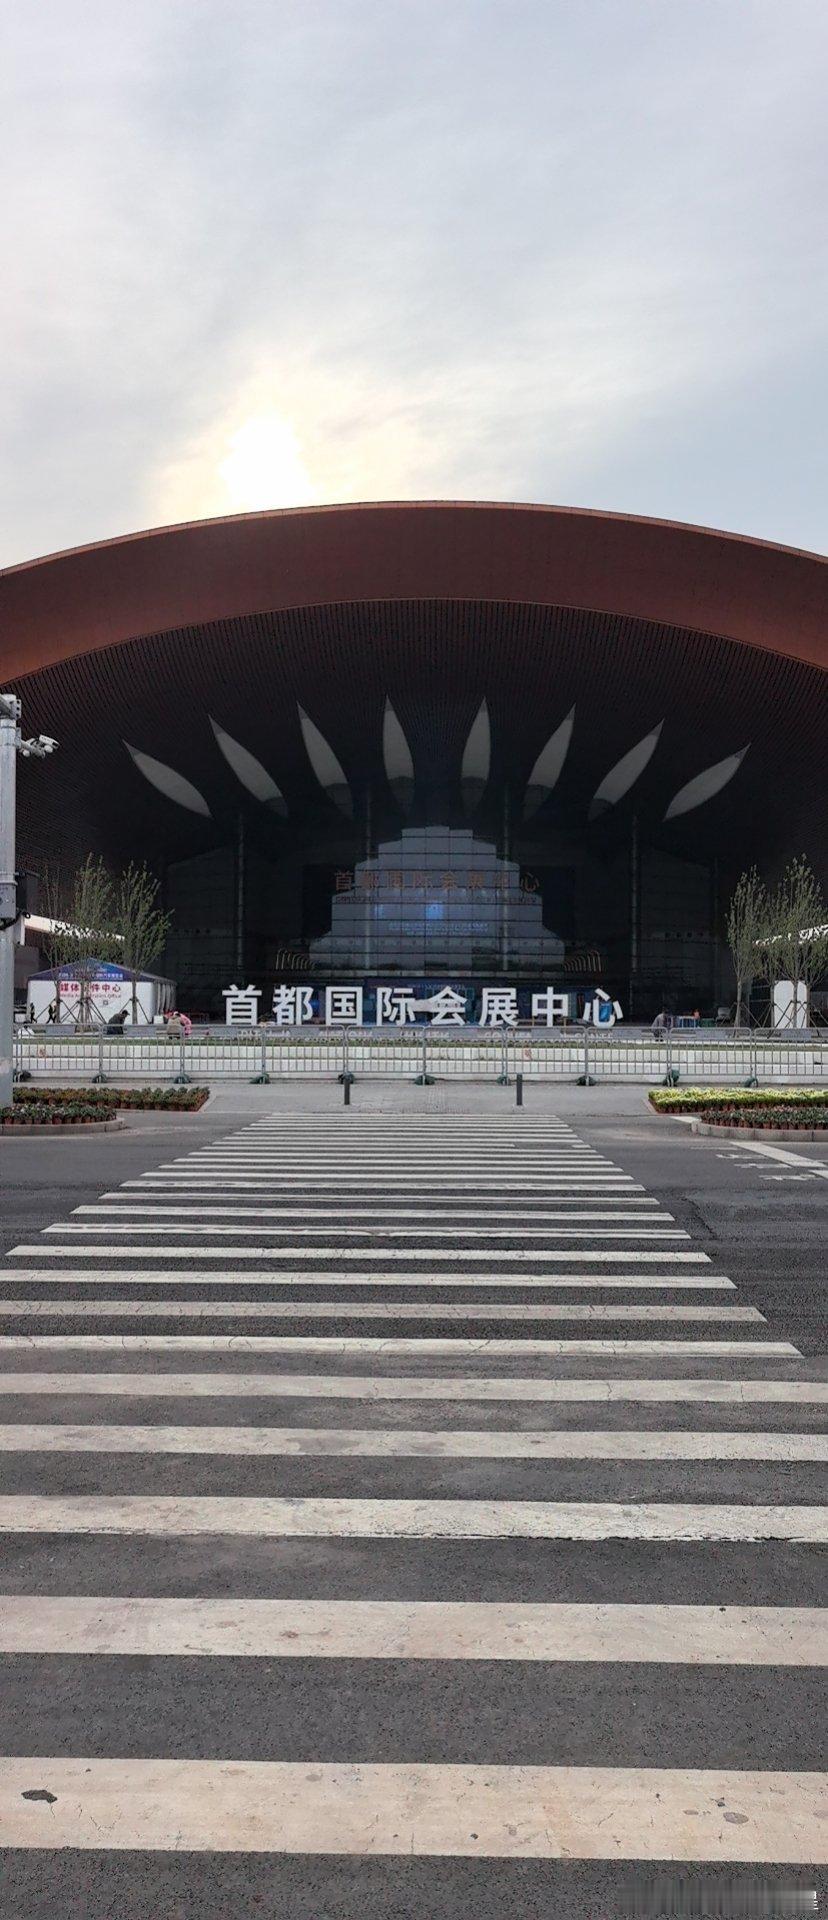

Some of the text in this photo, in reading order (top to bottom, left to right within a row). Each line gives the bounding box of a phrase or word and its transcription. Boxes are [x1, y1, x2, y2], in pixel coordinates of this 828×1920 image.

[60, 983, 121, 993] 媒体件中心
[222, 984, 624, 1027] 首都国际会展中心
